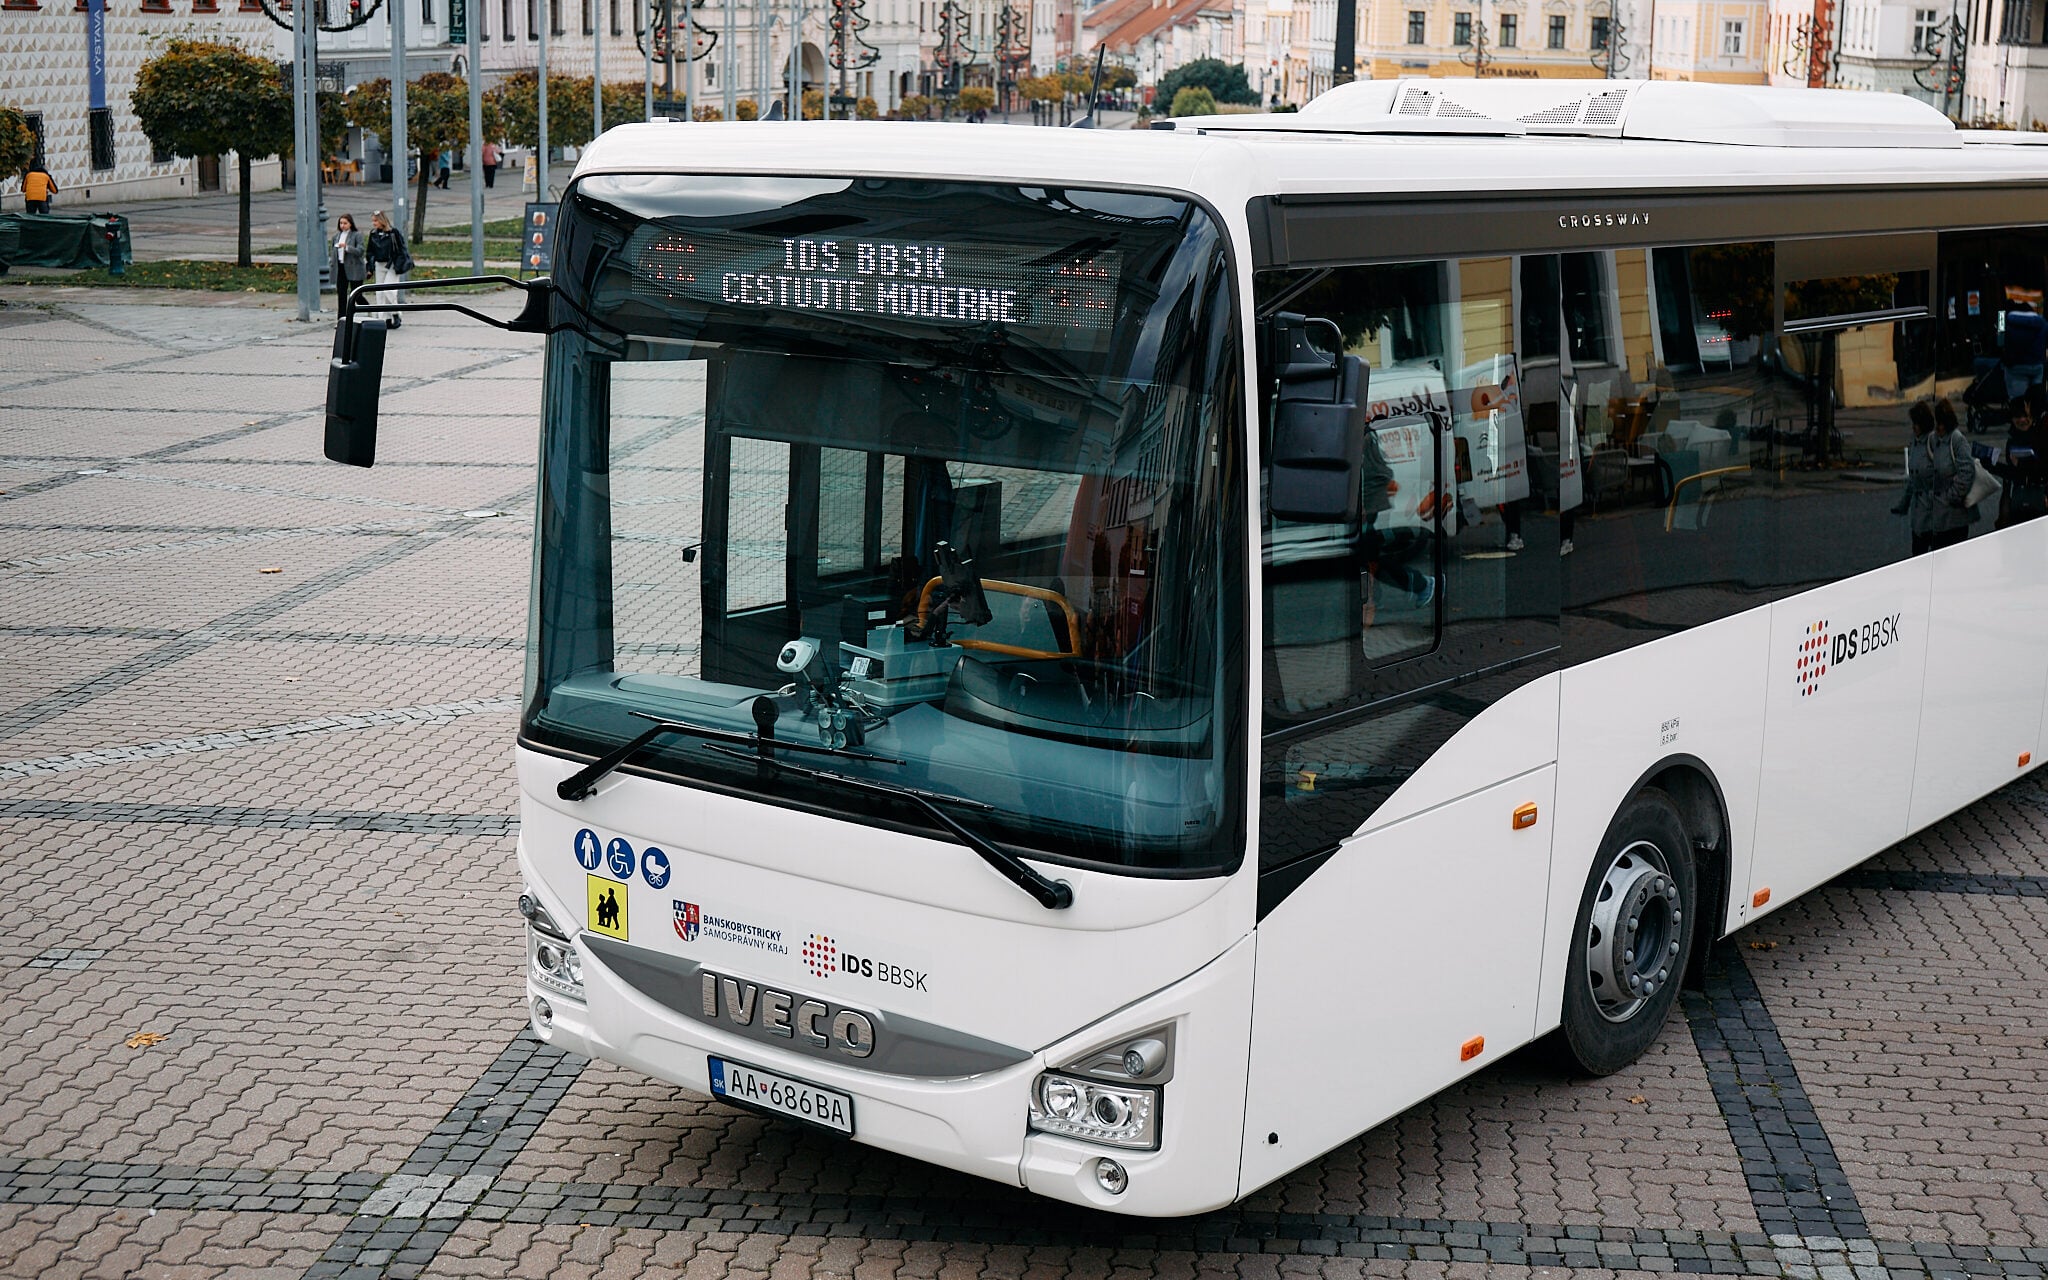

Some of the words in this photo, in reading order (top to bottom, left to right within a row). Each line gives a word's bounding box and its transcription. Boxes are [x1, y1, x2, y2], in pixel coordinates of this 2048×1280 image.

[93, 9, 102, 76] VÝSTAVA
[1559, 212, 1649, 228] CROSSWAY
[783, 239, 839, 272] IDS
[858, 243, 945, 279] BBSK
[722, 272, 865, 312] CESTUJTE
[877, 282, 1017, 323] MODERNE
[1831, 628, 1858, 667] IDS
[1861, 612, 1901, 655] BBSK
[703, 914, 781, 942] BANSKOBYSTRICKÝ
[703, 926, 765, 950] SAMOSPRÁVNY
[767, 942, 788, 955] KRAJ
[841, 952, 873, 978] IDS
[878, 961, 928, 993] BBSK
[702, 973, 876, 1058] IVECO
[713, 1078, 724, 1089] SK
